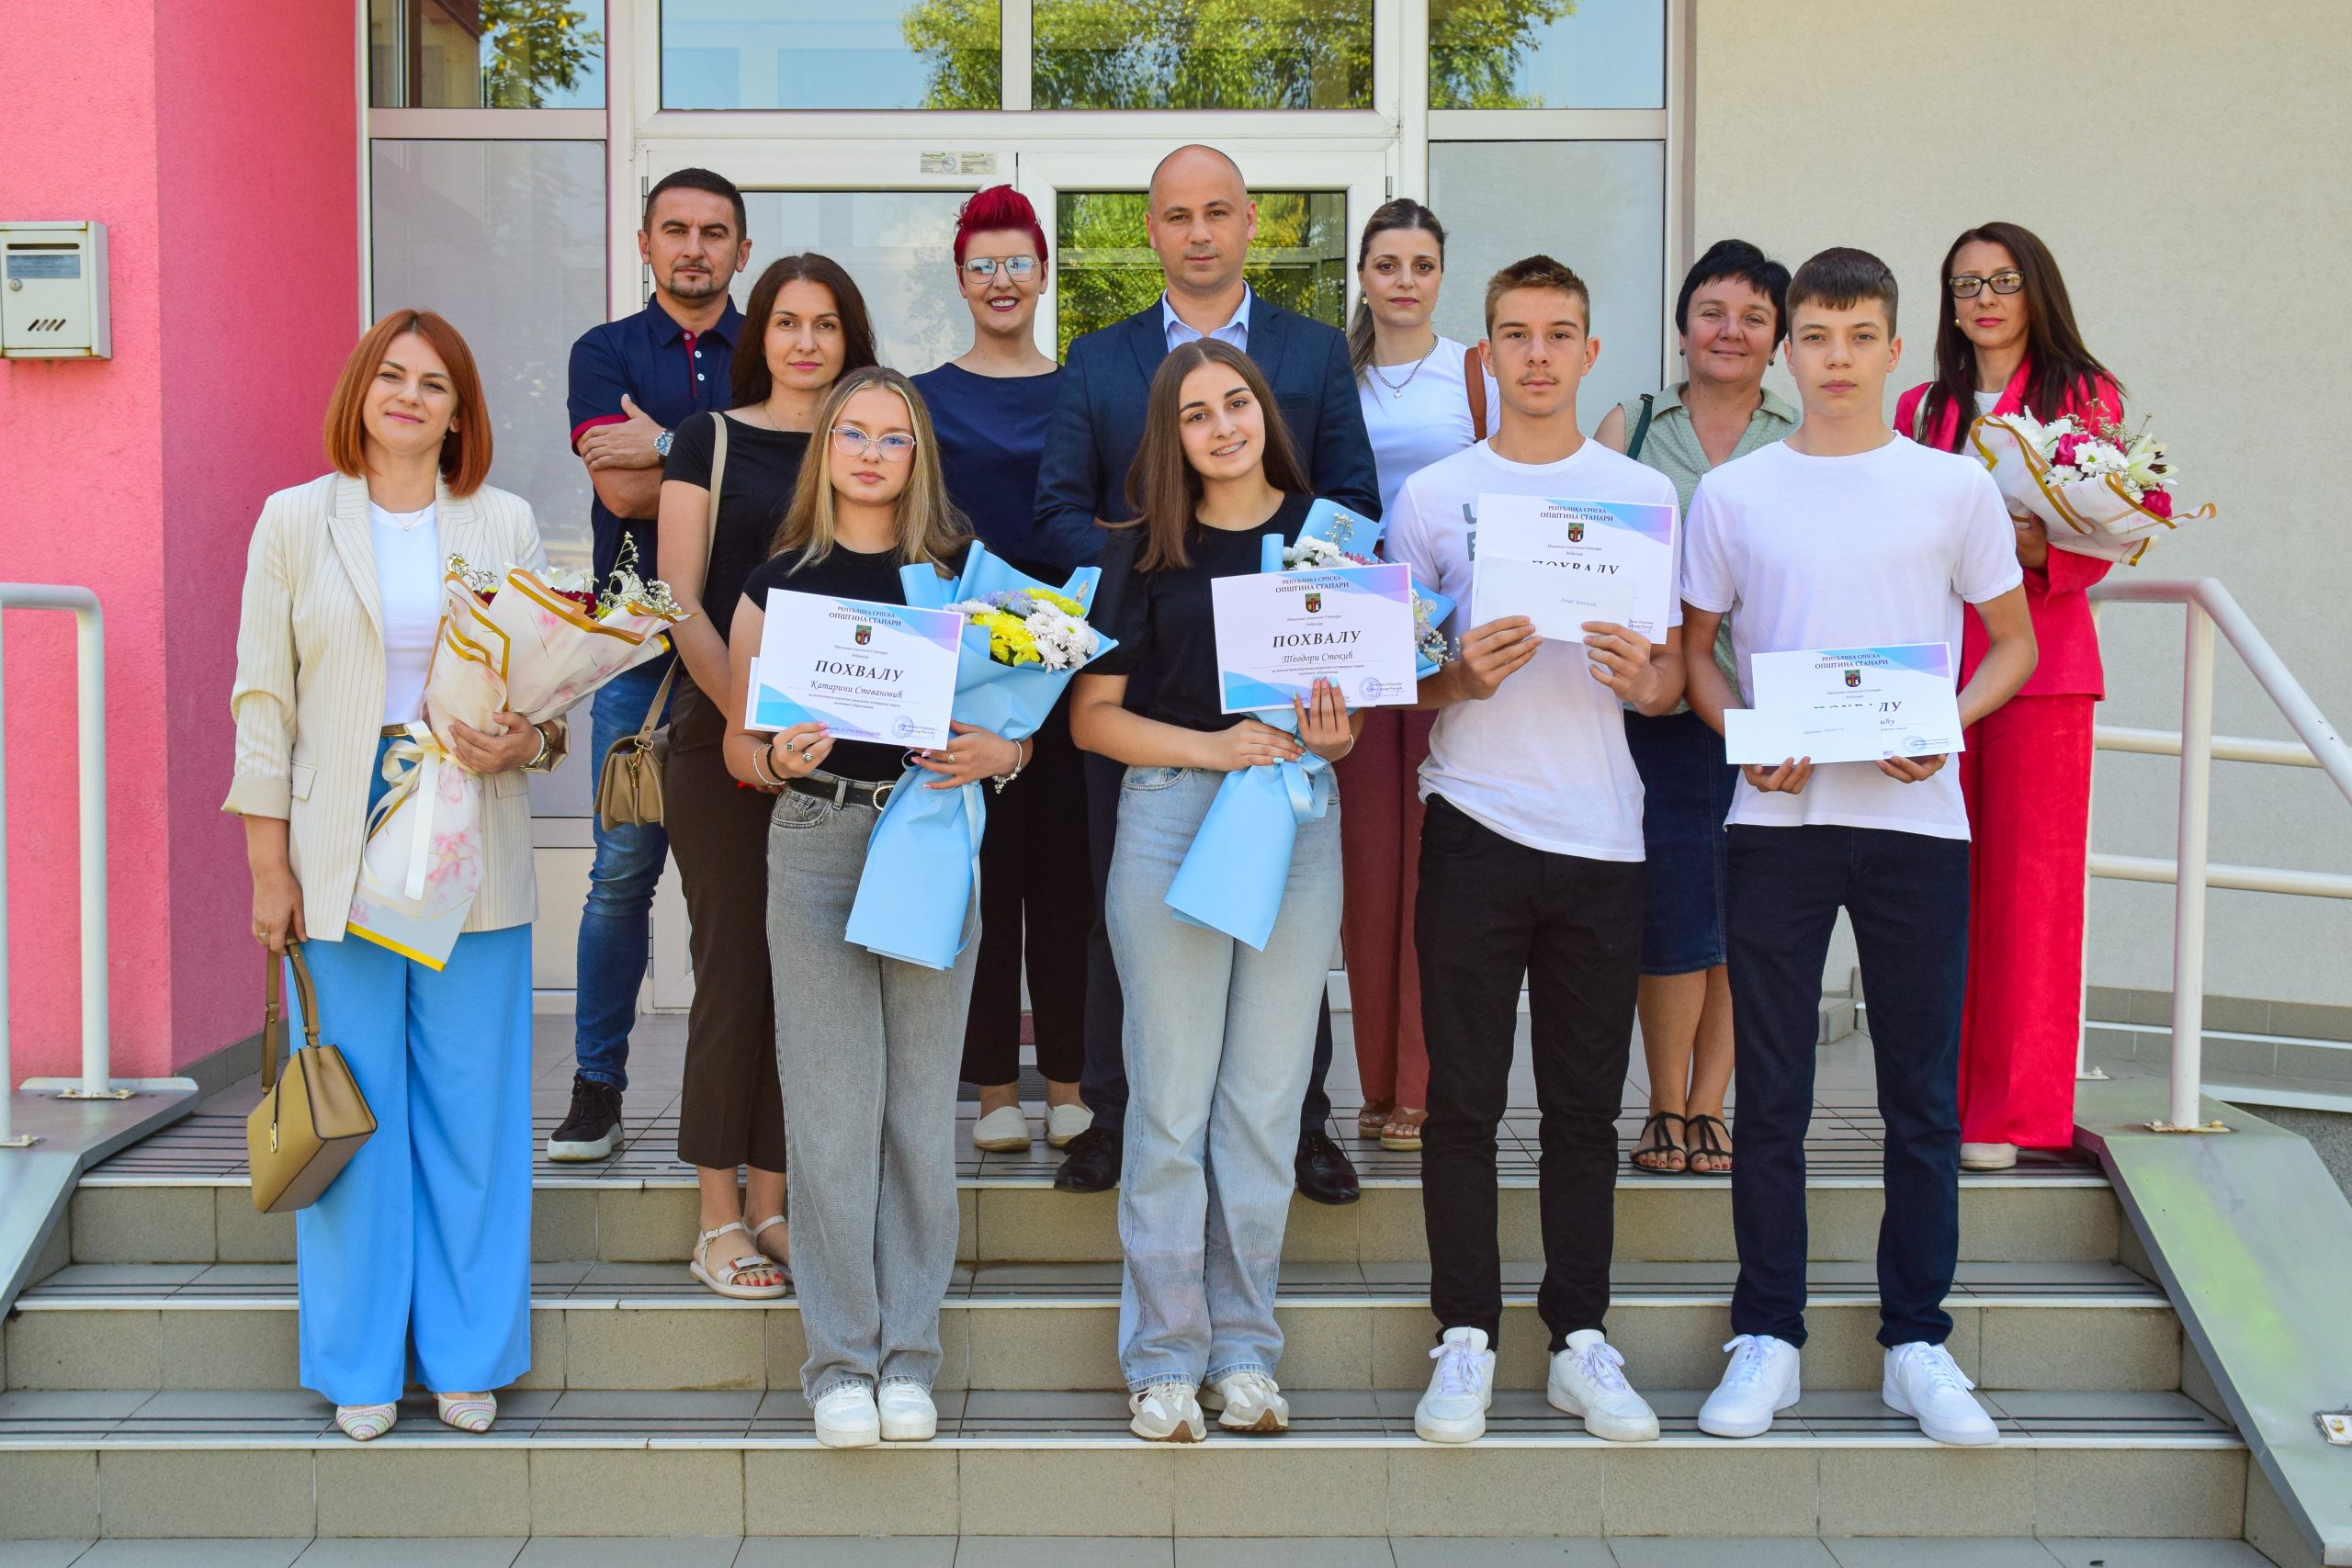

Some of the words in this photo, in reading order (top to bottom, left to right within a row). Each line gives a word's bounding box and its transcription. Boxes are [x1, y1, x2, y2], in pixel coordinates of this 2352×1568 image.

[1540, 512, 1578, 520] ОПШТИНА
[1580, 513, 1613, 522] СТАНАРИ
[1275, 585, 1314, 593] ОПШТИНА
[829, 612, 867, 623] ОПШТИНА
[869, 617, 901, 626] СТАНАРИ
[837, 606, 872, 615] РЕПУБЛИКА
[873, 610, 895, 618] СРПСКА
[1272, 630, 1362, 648] ПОХВАЛУ
[814, 660, 904, 682] ПОХВАЛУ
[809, 680, 853, 694] Катарини
